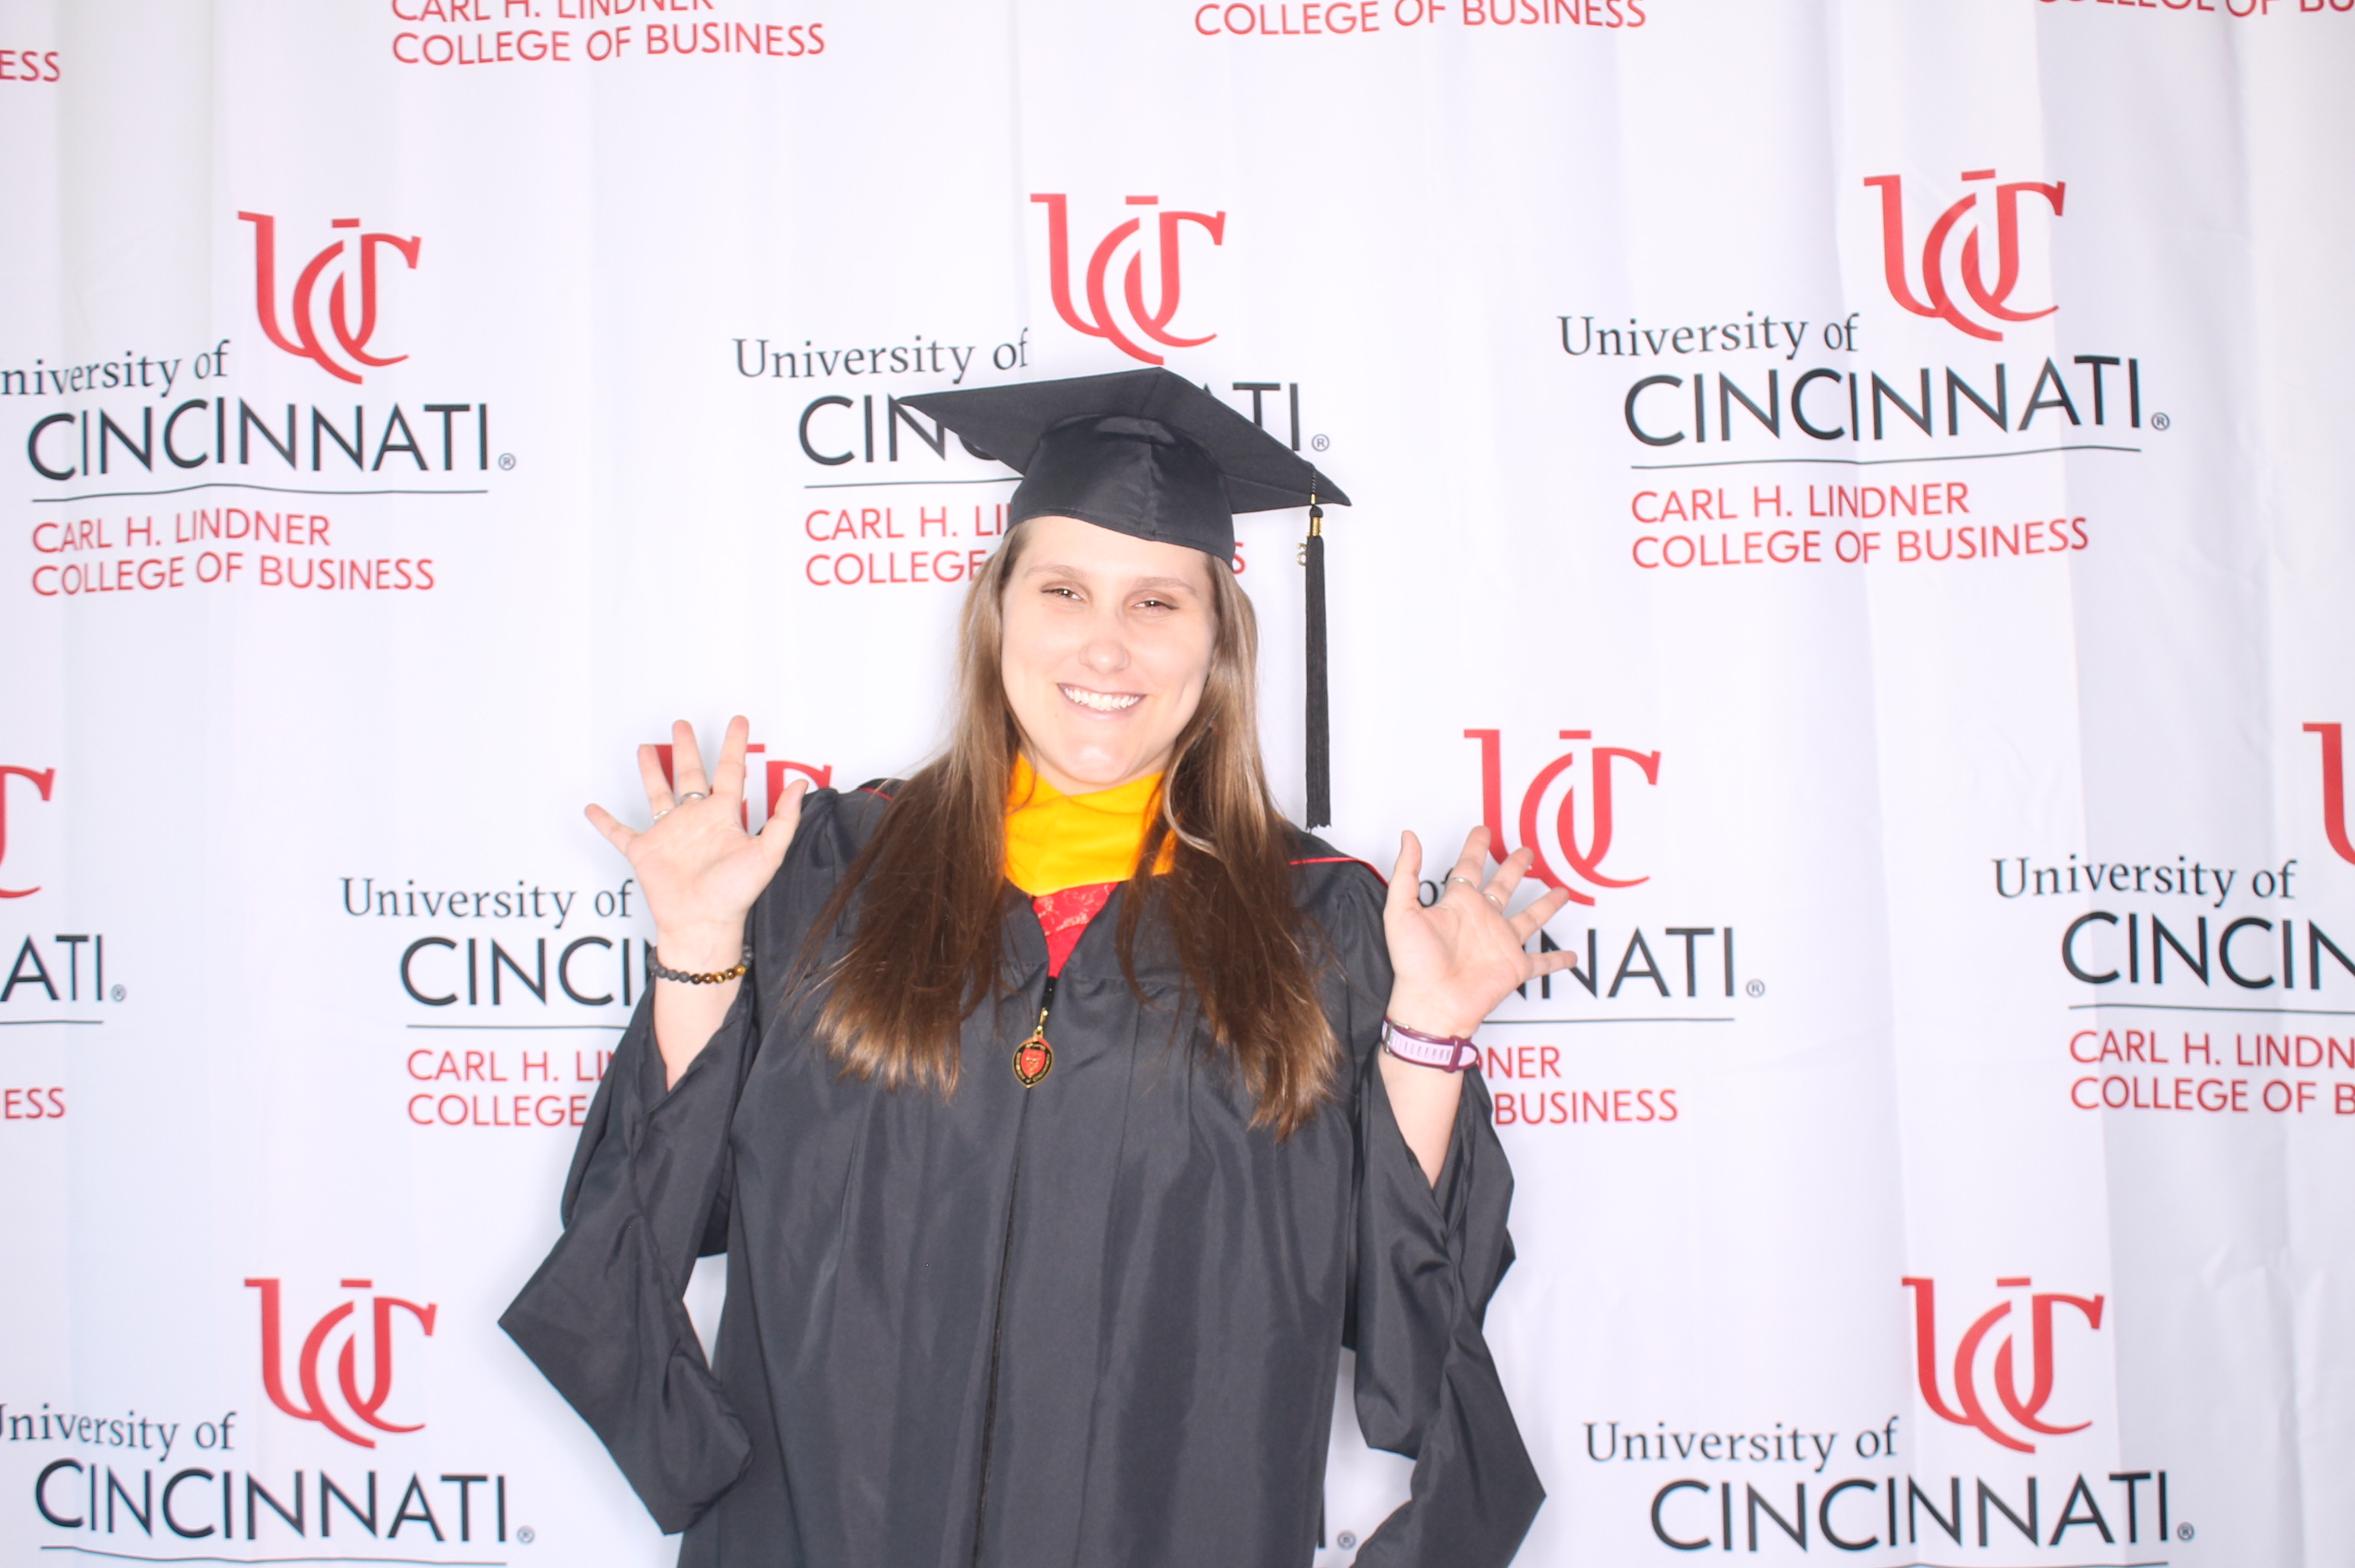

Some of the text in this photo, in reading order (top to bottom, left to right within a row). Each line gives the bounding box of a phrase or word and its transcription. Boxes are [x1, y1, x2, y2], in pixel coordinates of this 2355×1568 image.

[1194, 0, 1647, 36] COLLEGE OF BUSINESS
[392, 22, 826, 66] COLLEGE OF BUSINESS
[734, 328, 1030, 385] University of
[1557, 311, 1859, 361] University of
[0, 339, 230, 398] niversity of
[805, 506, 906, 542] CARL
[920, 506, 958, 538] H.
[1631, 481, 1971, 525] CARL H. LINDNER
[33, 507, 331, 554] CARL H. LINDNER
[1632, 516, 2090, 570] COLLEGE OF BUSINESS
[33, 551, 435, 597] COLLEGE OF BUSINESS
[1990, 853, 2298, 909] University of
[339, 878, 634, 930] University of
[2061, 910, 2355, 991] CINCIN
[407, 1048, 508, 1082] CARL
[522, 1051, 559, 1081] H.
[2069, 1029, 2355, 1069] CARL H. LINDN
[407, 1092, 588, 1127] COLLEGE
[1494, 1088, 1679, 1126] BUSINESS
[2070, 1075, 2250, 1113] COLLEGE
[2263, 1079, 2318, 1113] OF
[194, 1411, 237, 1451] of
[1582, 1416, 1899, 1475] University of
